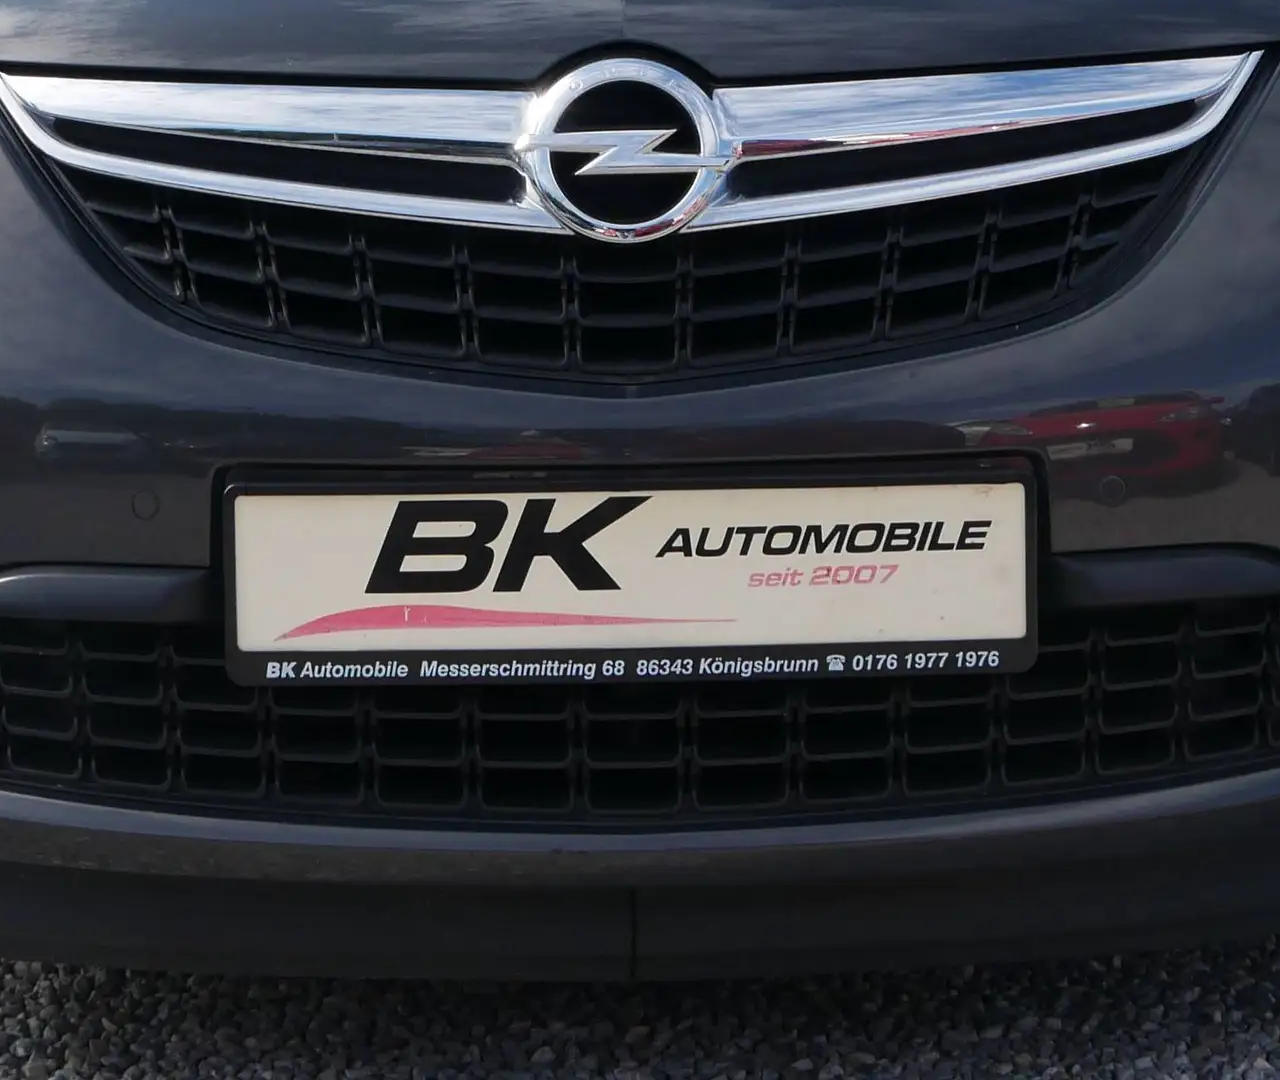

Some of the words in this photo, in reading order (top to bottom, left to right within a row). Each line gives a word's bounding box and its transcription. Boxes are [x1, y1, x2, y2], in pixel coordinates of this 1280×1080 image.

[364, 495, 654, 594] BK
[655, 520, 993, 558] AUTOMOBILE
[747, 568, 804, 588] seit
[809, 564, 899, 587] 2007
[265, 661, 297, 679] BK
[299, 660, 409, 679] Automobile
[419, 659, 597, 680] Messerschmittring
[601, 659, 625, 676] 68
[635, 658, 693, 676] 86343
[698, 657, 819, 677] Königsbrunn
[851, 654, 898, 671] 0176
[904, 652, 948, 669] 1977
[955, 650, 1000, 668] 1976
